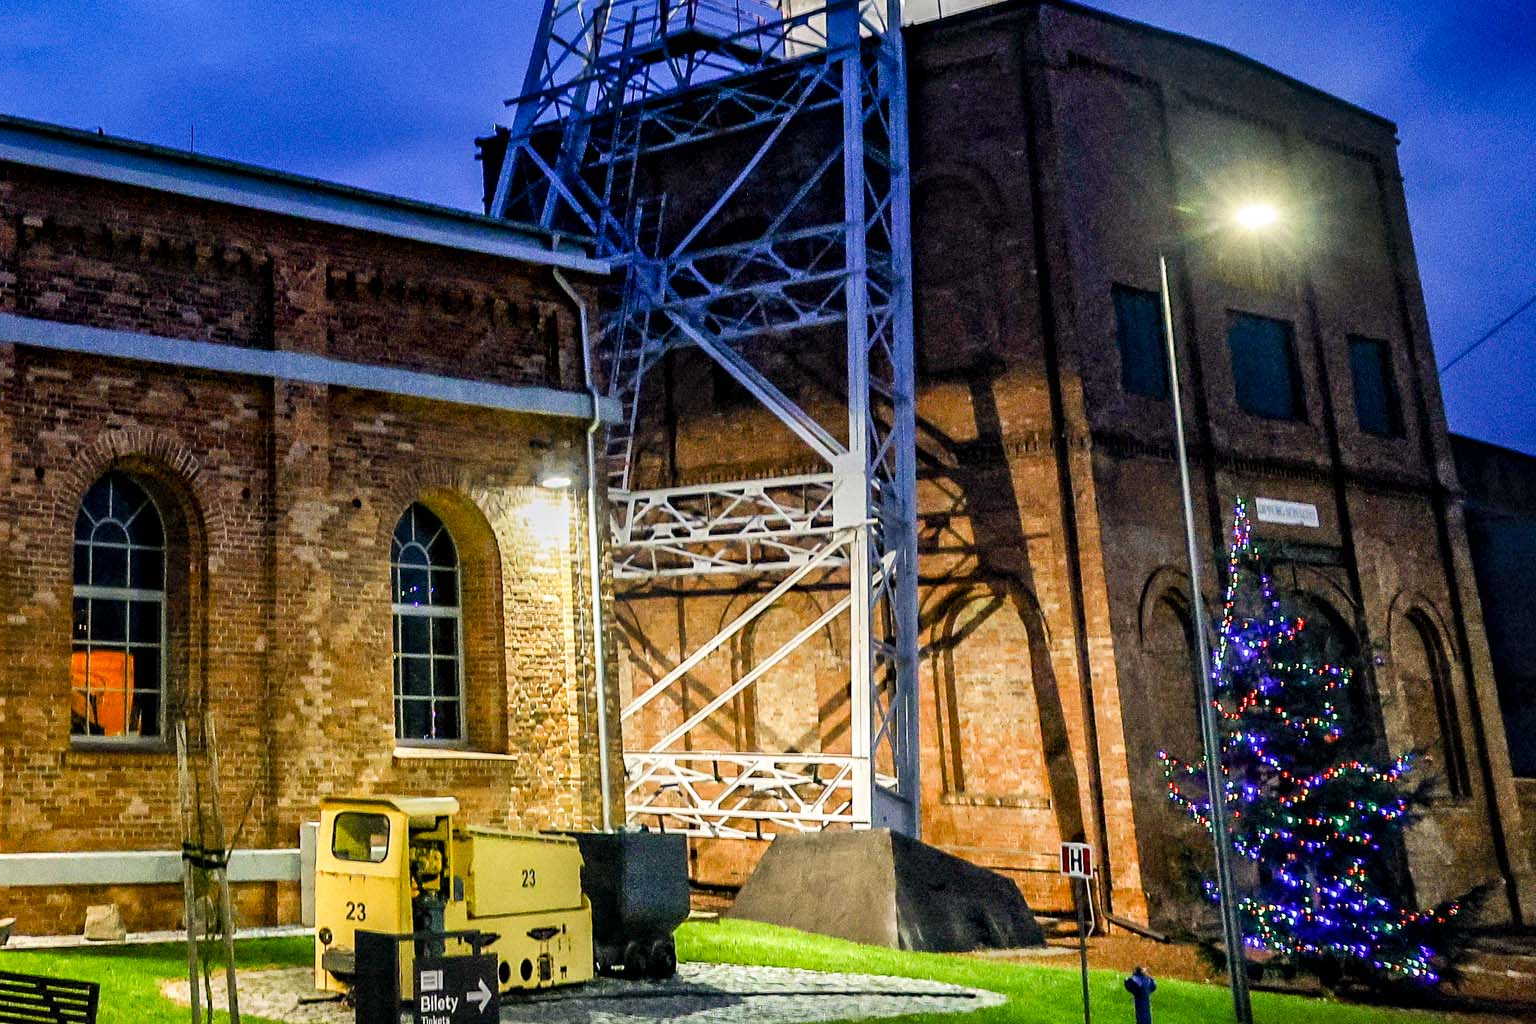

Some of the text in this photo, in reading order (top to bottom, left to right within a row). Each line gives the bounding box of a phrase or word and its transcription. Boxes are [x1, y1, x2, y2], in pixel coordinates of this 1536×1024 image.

[1071, 849, 1082, 872] H
[522, 869, 535, 888] 23
[346, 901, 366, 921] 23
[420, 994, 459, 1014] Bilety
